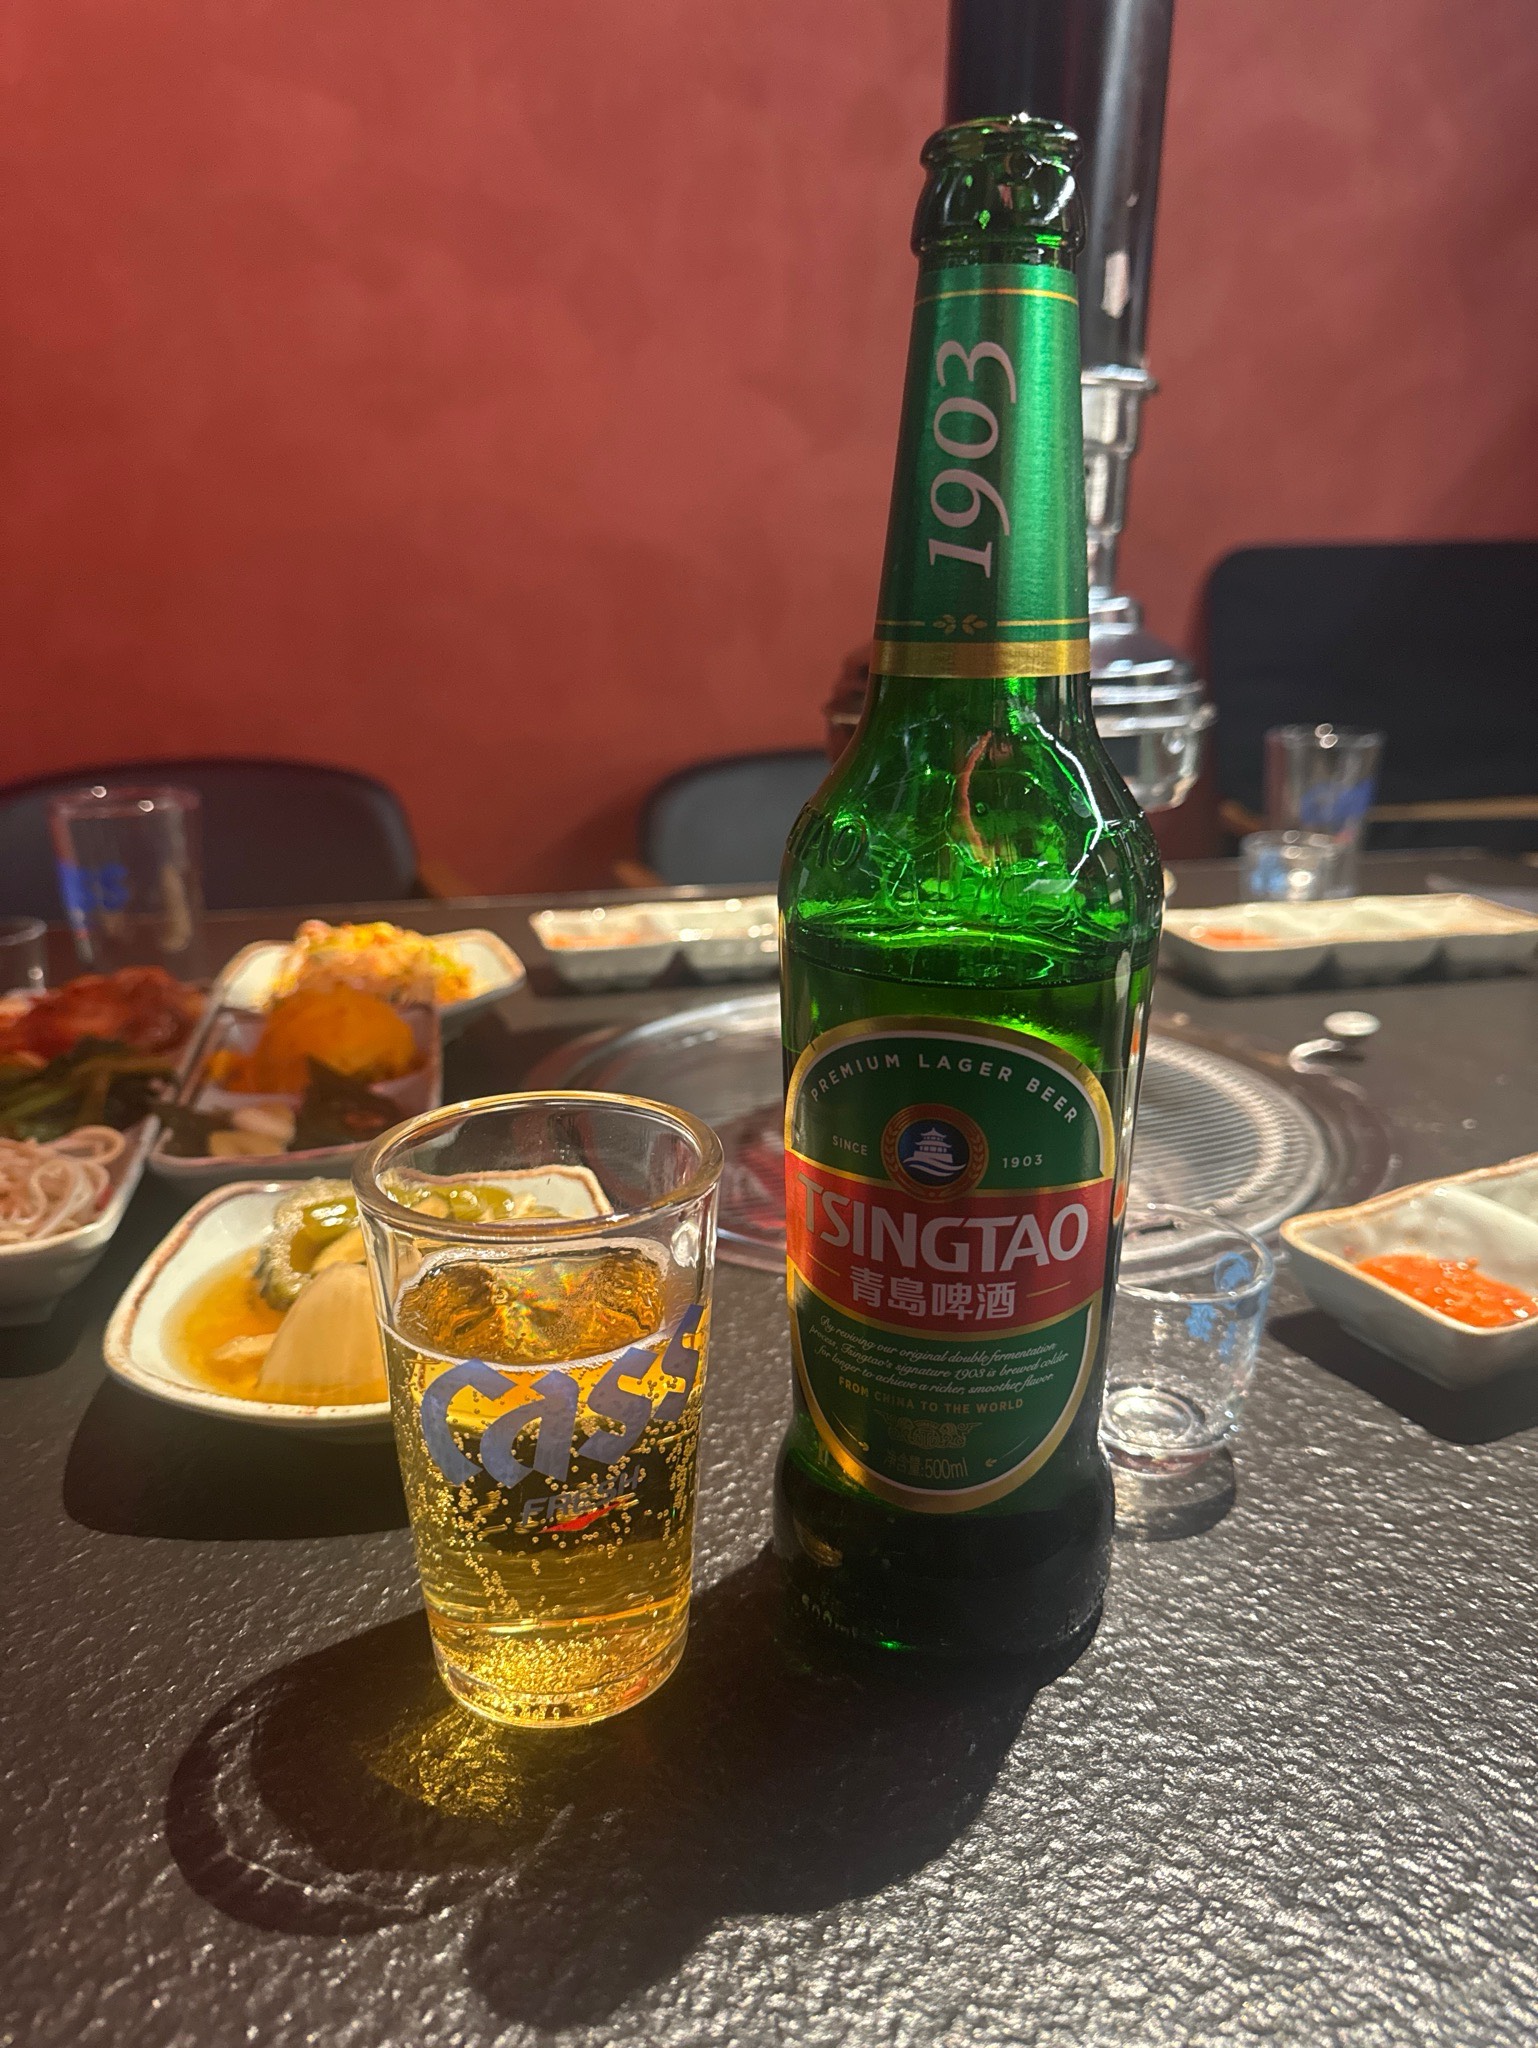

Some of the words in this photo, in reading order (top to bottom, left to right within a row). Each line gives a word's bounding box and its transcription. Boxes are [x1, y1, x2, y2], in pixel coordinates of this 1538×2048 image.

[928, 340, 1017, 579] 1903
[811, 1053, 900, 1102] PREMIUM
[918, 1053, 1013, 1083] LAGER
[1025, 1077, 1078, 1123] BEER
[832, 1135, 868, 1156] SINCE
[1002, 1153, 1043, 1169] 1903
[797, 1172, 1089, 1273] TSINGTAO
[849, 1265, 1017, 1321] 青島啤酒
[820, 1315, 835, 1332] By
[835, 1326, 876, 1350] reviving
[877, 1344, 898, 1354] our
[899, 1348, 950, 1362] original
[948, 1350, 990, 1363] double
[981, 1343, 1057, 1366] fermentation
[841, 1343, 893, 1369] Tsingtao's
[895, 1363, 952, 1377] signature
[954, 1368, 985, 1380] 1903
[986, 1368, 997, 1377] is
[999, 1358, 1041, 1376] brewed
[1040, 1350, 1069, 1368] colder
[814, 1345, 831, 1358] for
[832, 1354, 861, 1373] longer
[862, 1368, 875, 1379] to
[875, 1374, 918, 1389] achieve
[918, 1383, 929, 1391] a
[929, 1381, 966, 1395] richer,
[968, 1379, 1023, 1393] smoother
[1015, 1373, 1054, 1393] flavor.
[838, 1376, 869, 1398] FROM
[874, 1391, 915, 1410] CHINA
[920, 1400, 938, 1412] TO
[944, 1403, 970, 1414] THE
[975, 1398, 1023, 1414] WORLD
[522, 1464, 640, 1526] FRESH
